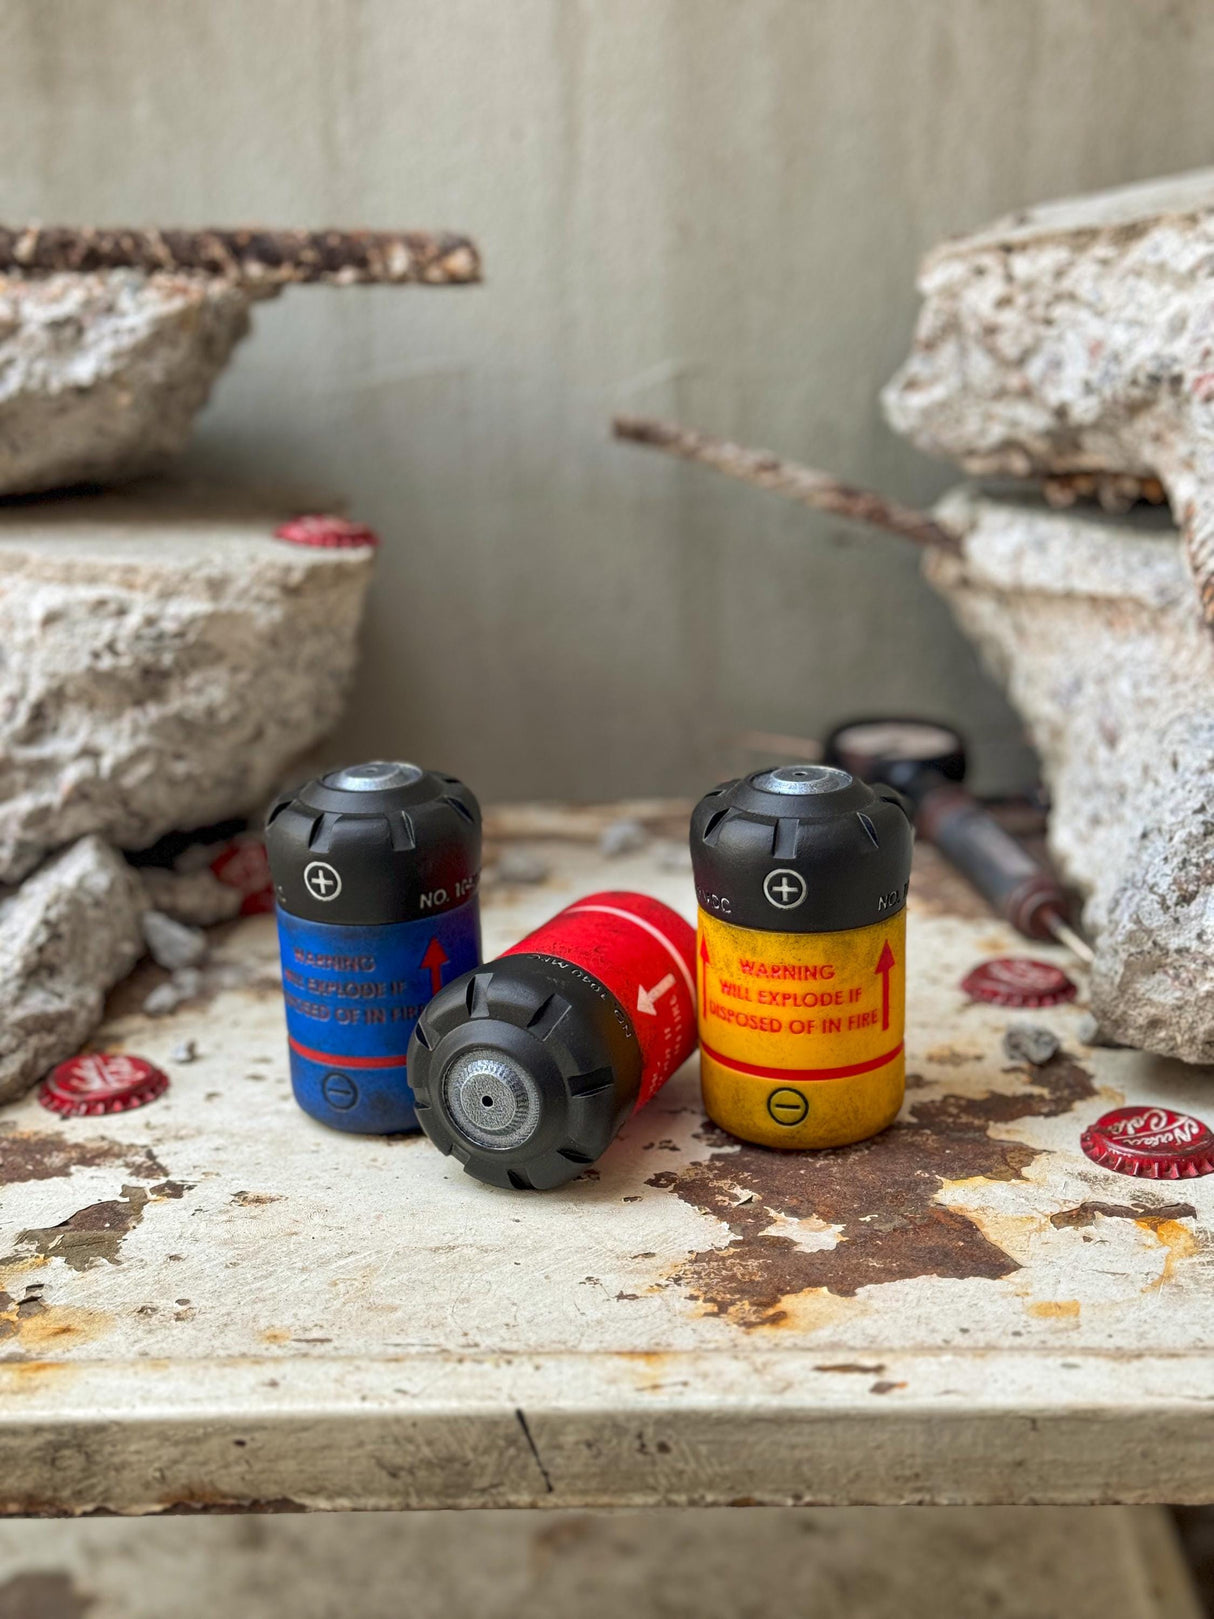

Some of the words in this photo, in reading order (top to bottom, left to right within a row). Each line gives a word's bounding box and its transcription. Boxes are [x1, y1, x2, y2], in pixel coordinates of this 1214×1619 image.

[294, 947, 375, 973] WARNING
[739, 959, 835, 981] WARNING
[307, 978, 387, 999] EXPLODE
[720, 979, 752, 1002] WILL
[757, 989, 844, 1008] EXPLODE
[849, 987, 862, 1003] IF
[335, 1007, 361, 1025] OF
[364, 1007, 386, 1024] IN
[709, 999, 782, 1033] DISPOSED
[788, 1019, 815, 1035] OF
[822, 1018, 841, 1034] IN
[848, 1009, 878, 1031] FIRE
